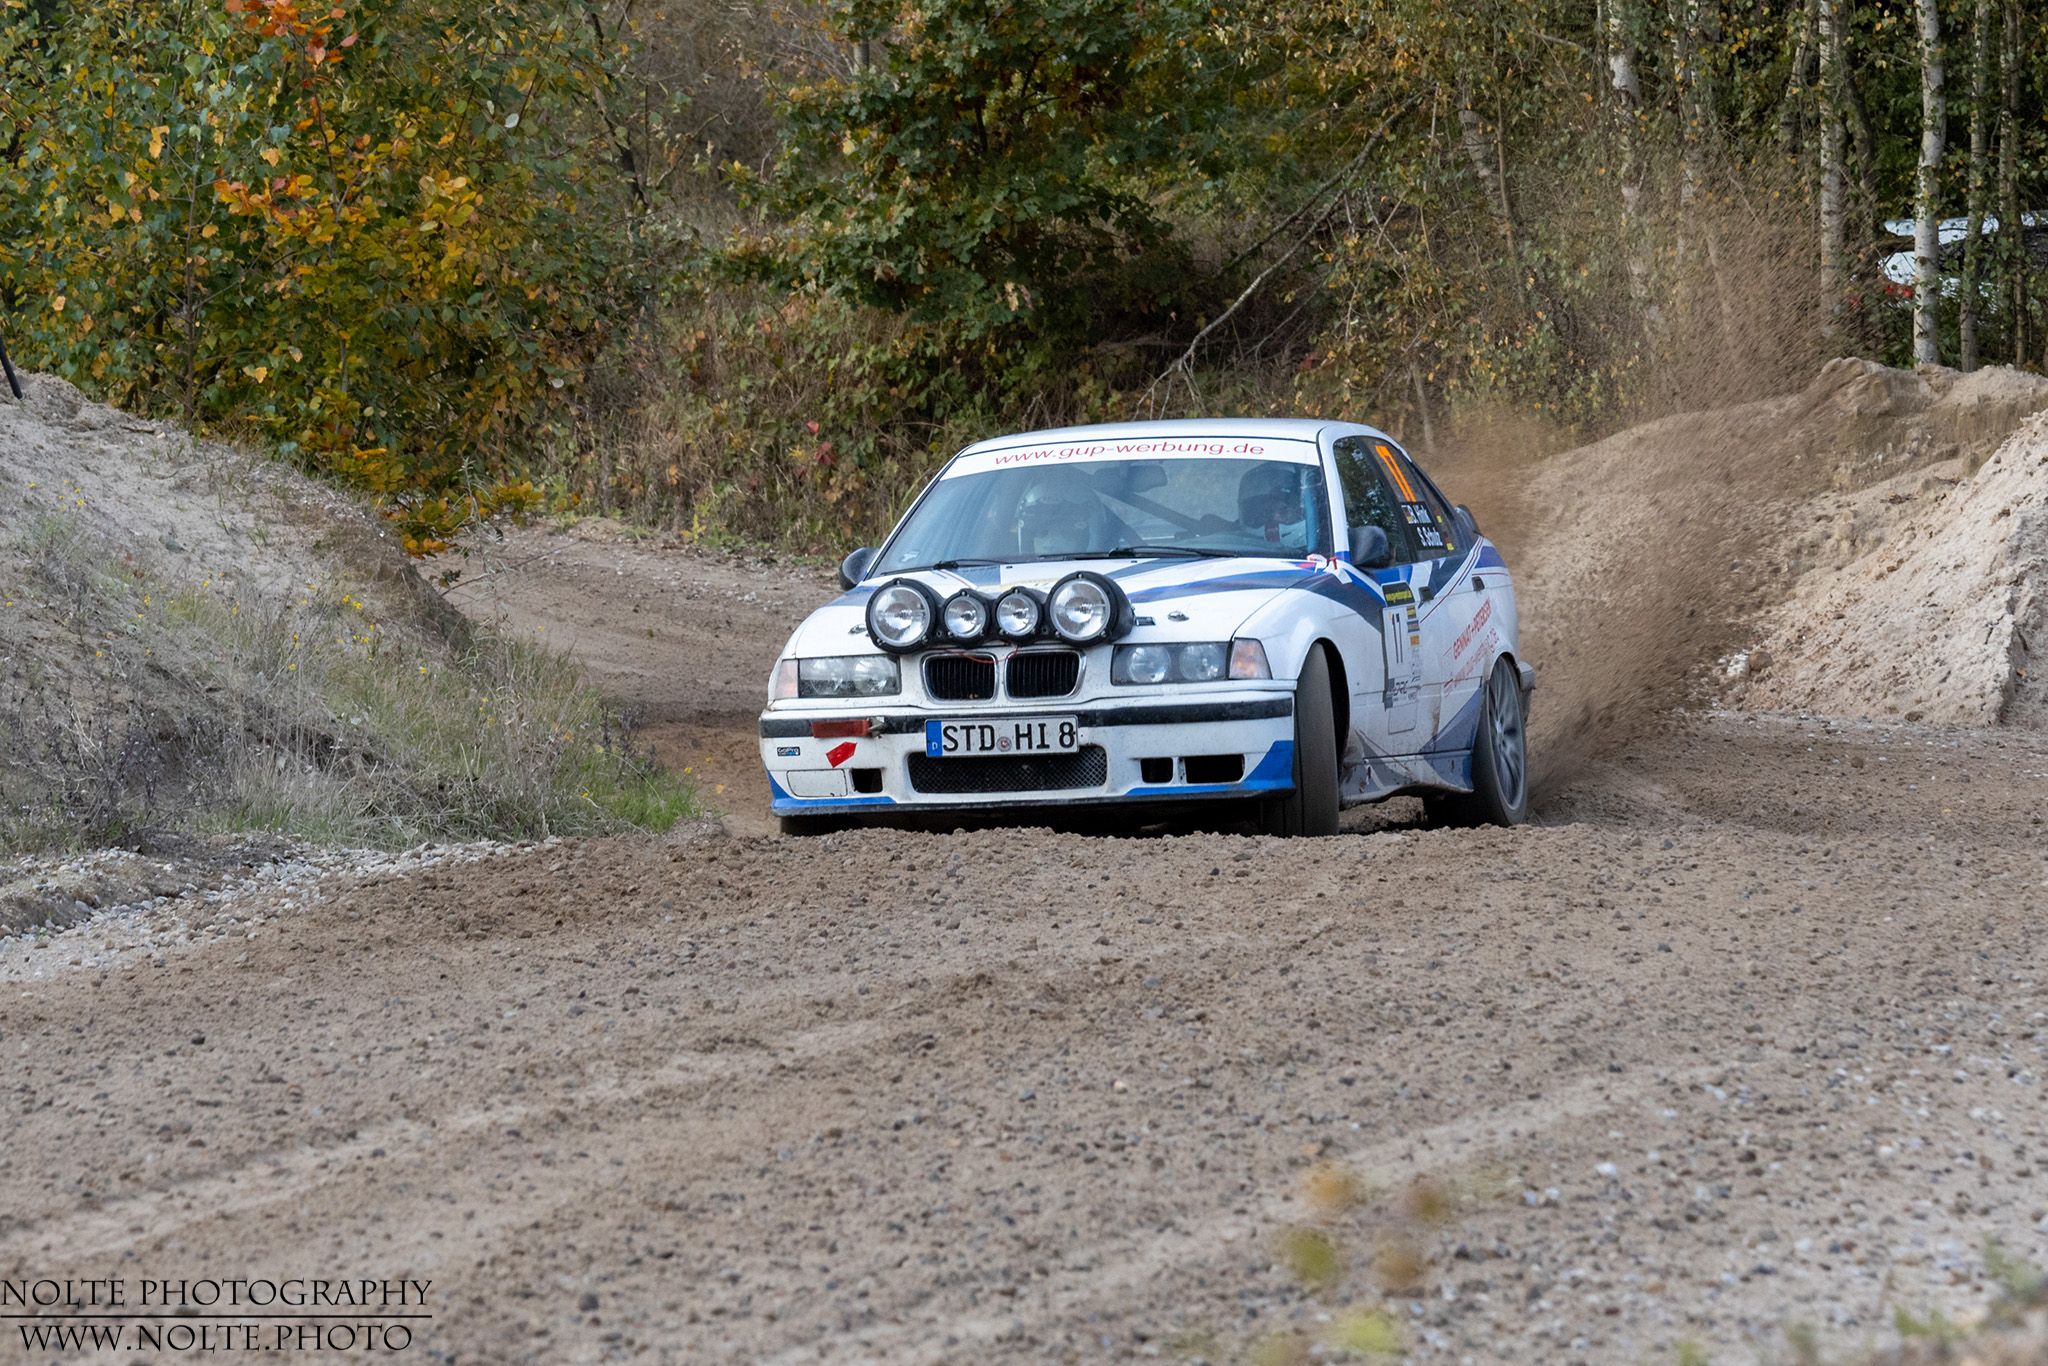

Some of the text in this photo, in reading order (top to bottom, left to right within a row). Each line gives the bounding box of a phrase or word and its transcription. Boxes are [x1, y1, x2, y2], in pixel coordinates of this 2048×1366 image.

[994, 441, 1264, 466] www.gup-werbung.de
[931, 721, 1075, 752] D STD HI 8
